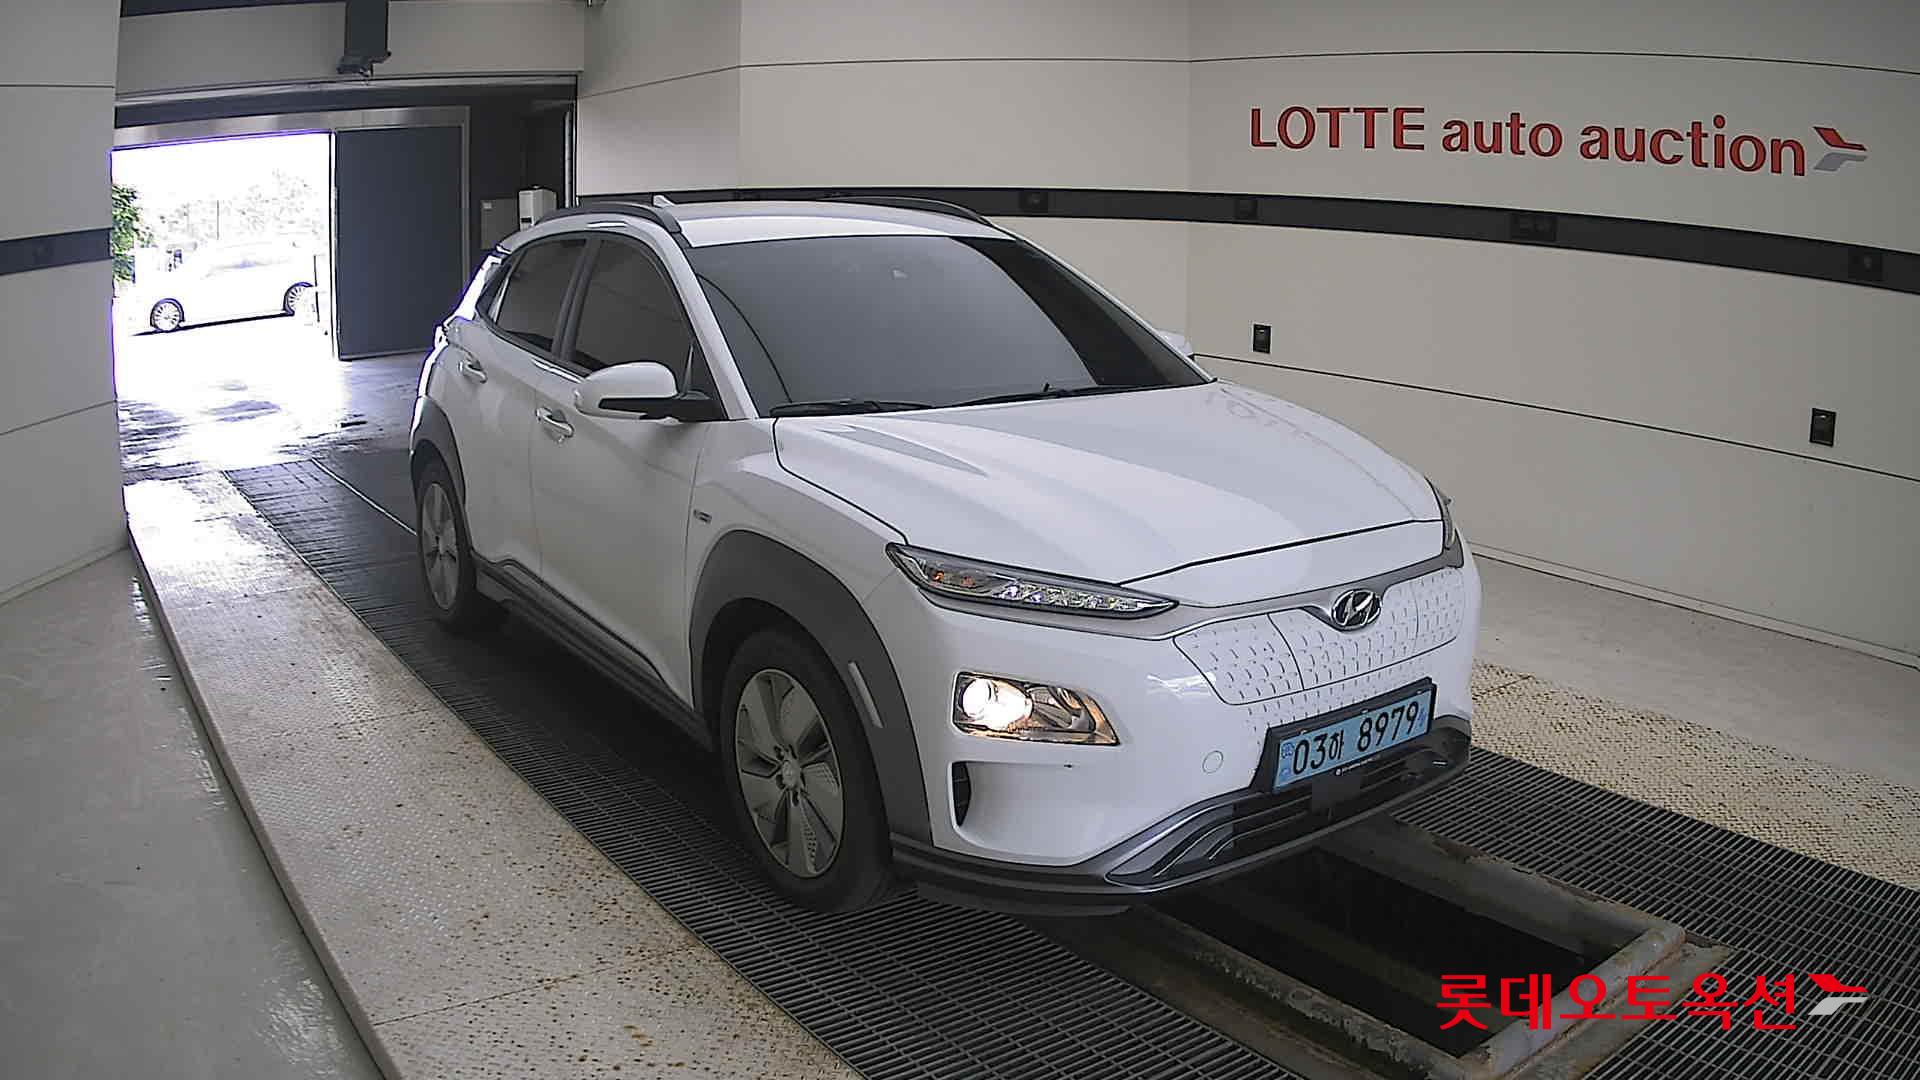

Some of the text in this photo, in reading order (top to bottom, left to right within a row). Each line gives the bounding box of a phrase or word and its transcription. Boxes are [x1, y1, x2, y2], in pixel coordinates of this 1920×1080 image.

[1250, 106, 1806, 177] LOTTE auto auction
[1293, 729, 1345, 775] 03하
[1357, 701, 1420, 752] 8979
